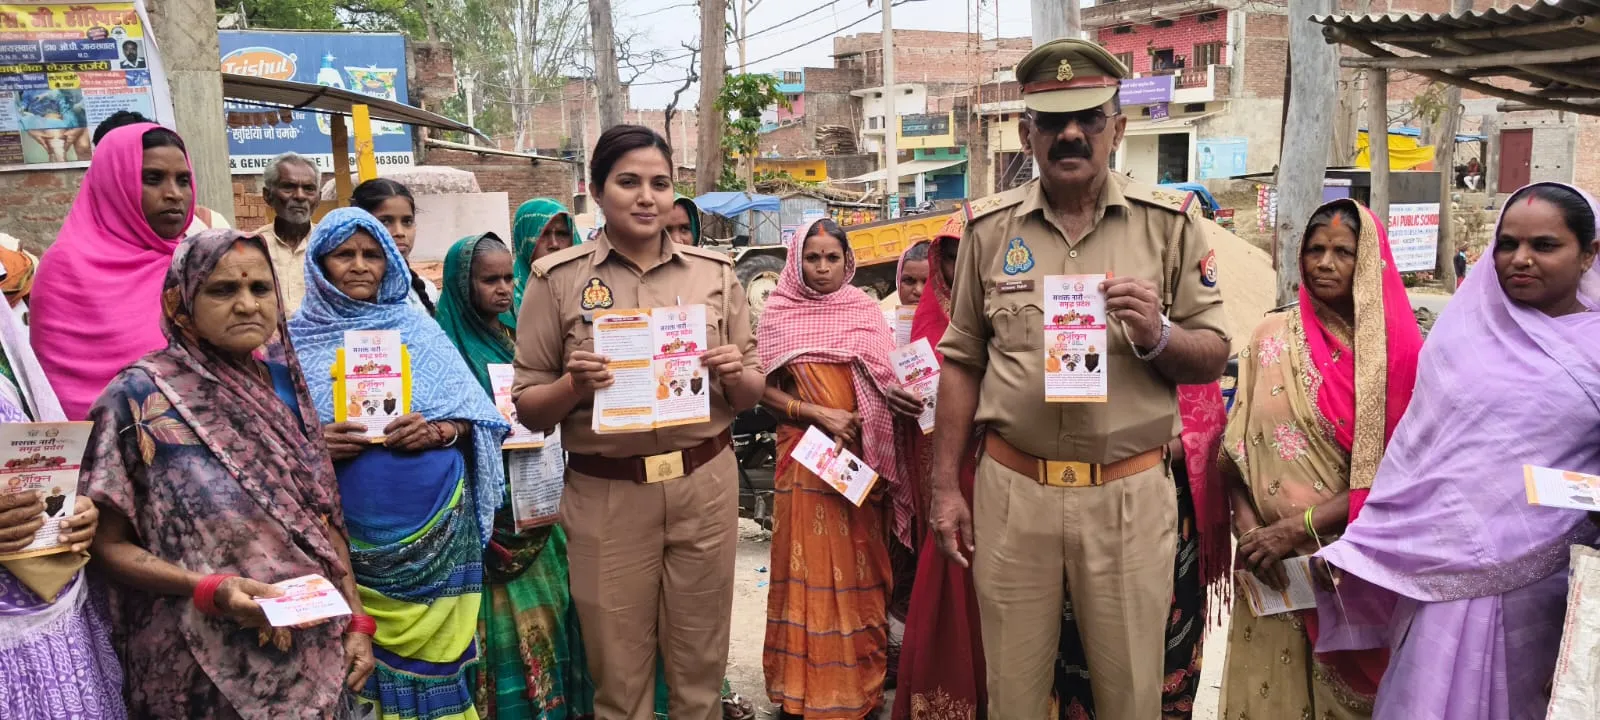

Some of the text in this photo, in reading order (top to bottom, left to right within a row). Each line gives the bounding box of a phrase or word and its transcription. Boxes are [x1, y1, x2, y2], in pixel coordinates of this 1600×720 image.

[28, 7, 61, 27] जी.
[225, 58, 288, 77] Trishul
[230, 158, 237, 168] &
[240, 158, 273, 168] GENE
[1400, 214, 1420, 227] PUBLIC
